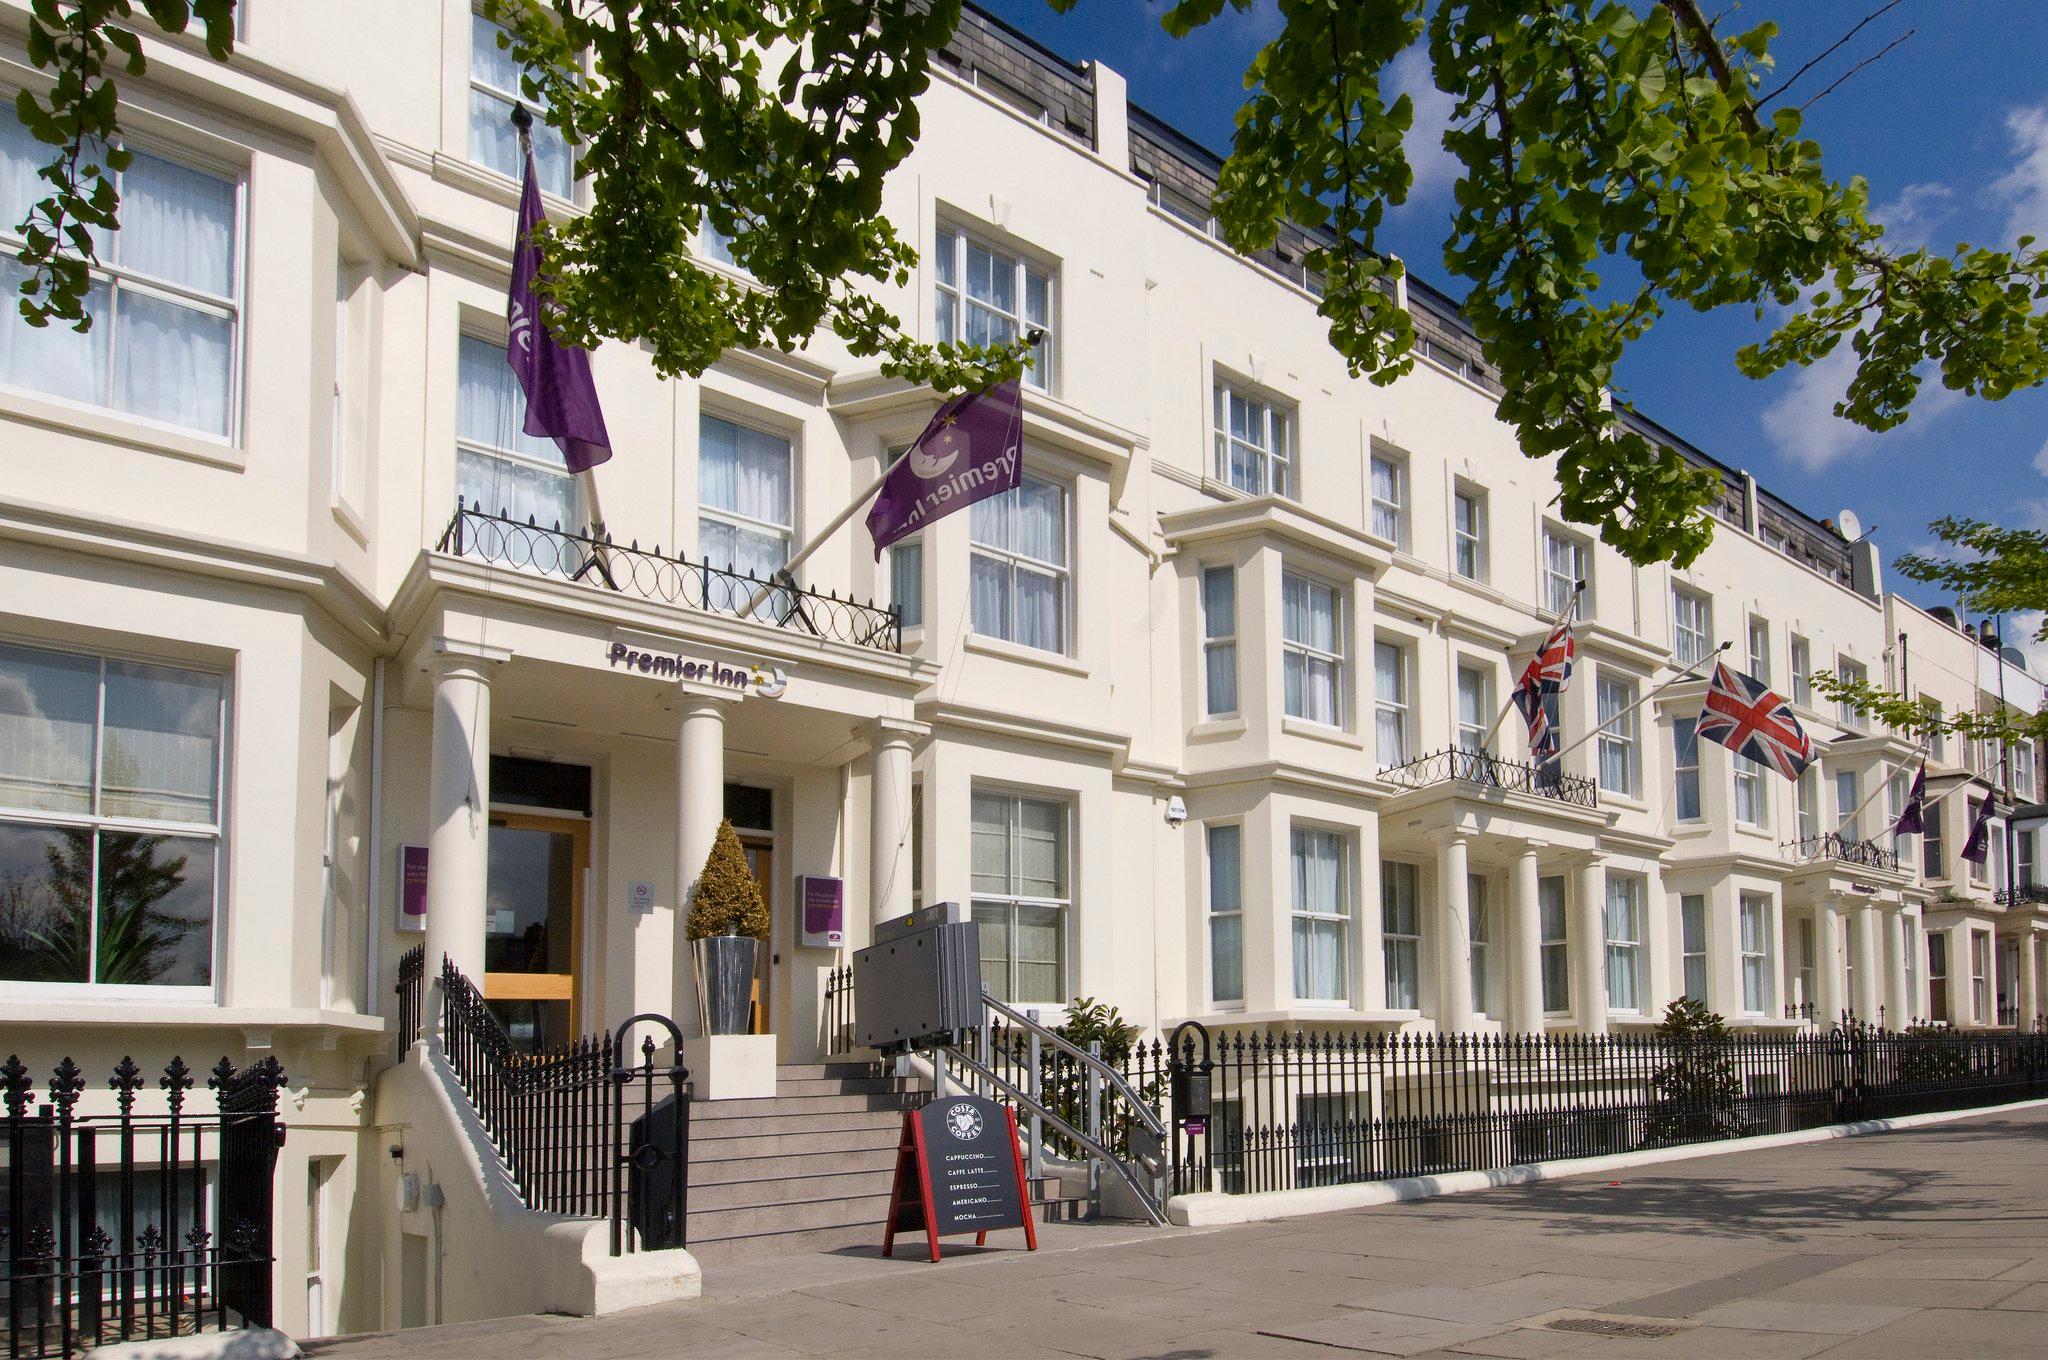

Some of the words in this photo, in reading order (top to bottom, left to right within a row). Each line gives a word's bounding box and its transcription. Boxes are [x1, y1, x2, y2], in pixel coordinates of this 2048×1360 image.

[610, 642, 709, 681] Premier
[712, 661, 748, 689] Inn
[950, 1105, 975, 1116] COSTA
[951, 1124, 981, 1139] COFFEE
[945, 1153, 984, 1161] CAPPUCCINO
[949, 1183, 978, 1191] ESPRESSO
[952, 1197, 987, 1206] AMERICANO
[954, 1213, 977, 1221] MOCHA
